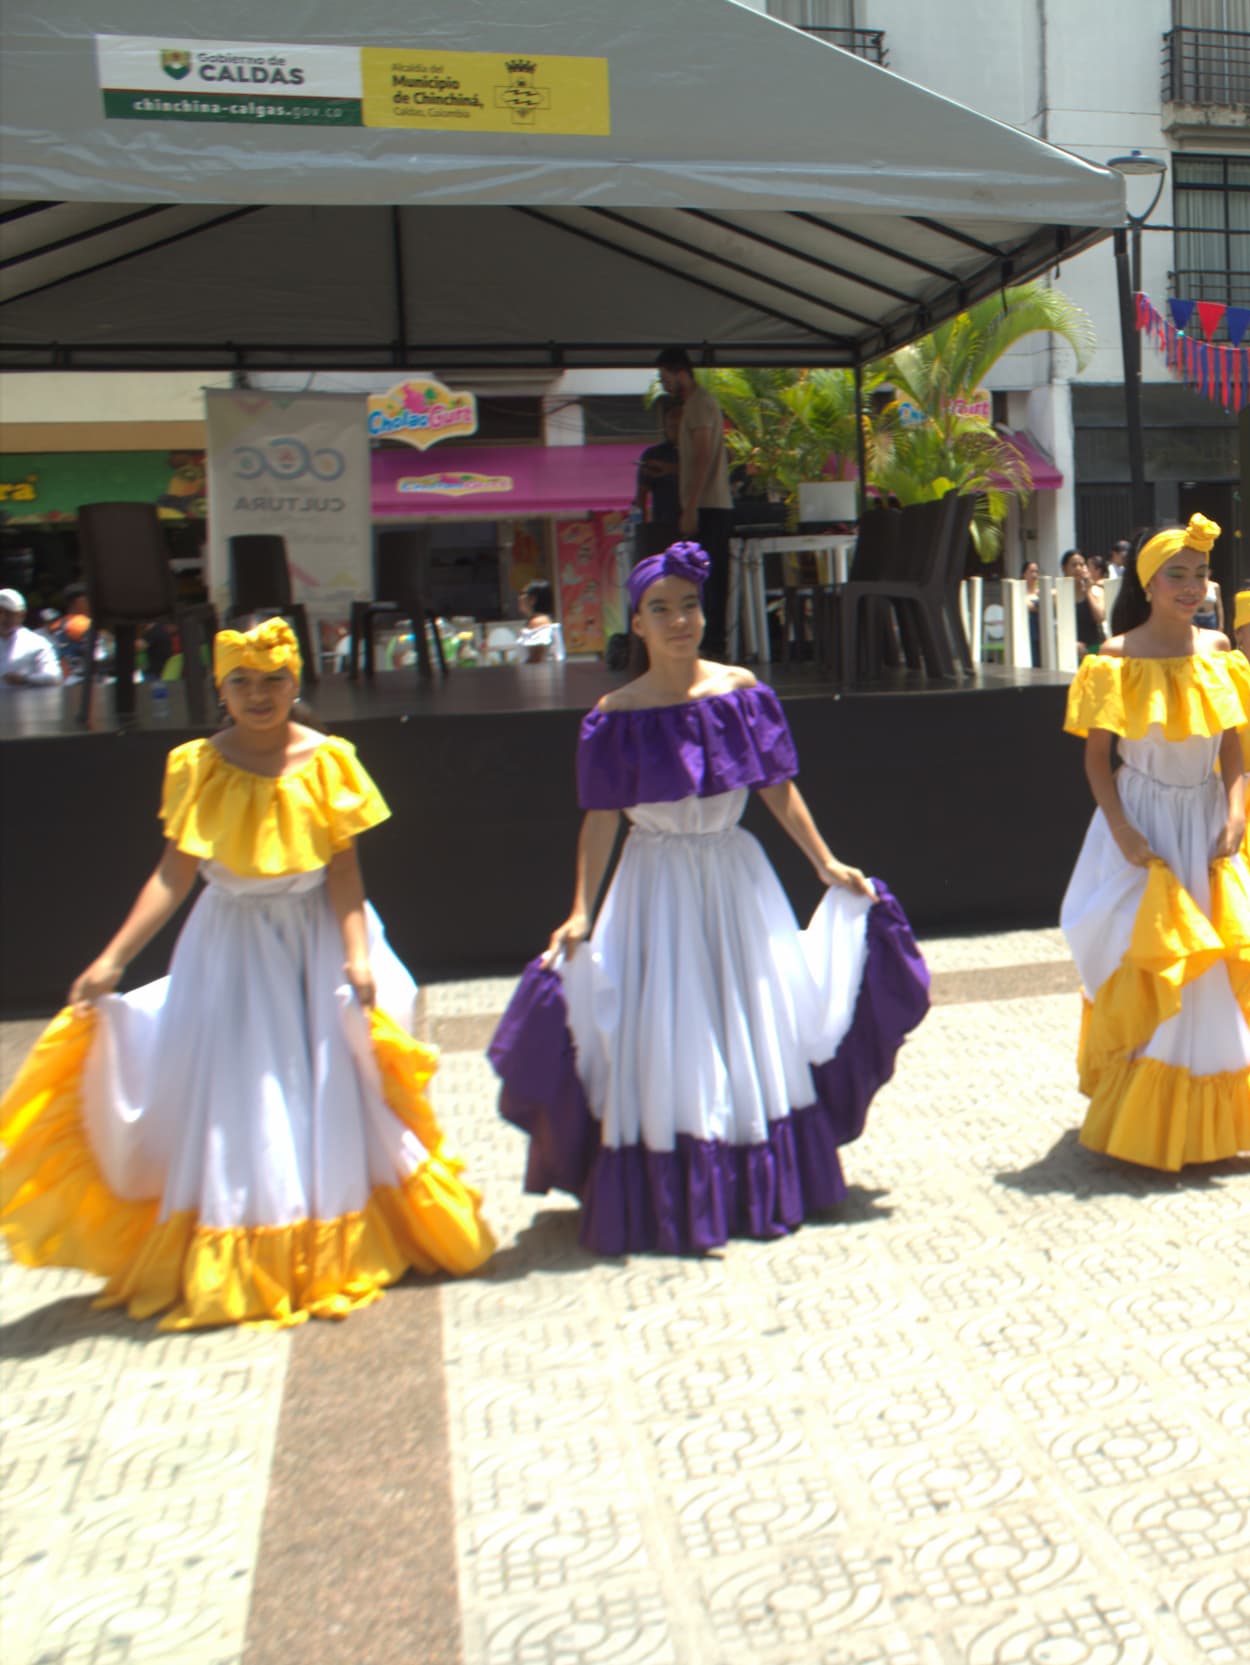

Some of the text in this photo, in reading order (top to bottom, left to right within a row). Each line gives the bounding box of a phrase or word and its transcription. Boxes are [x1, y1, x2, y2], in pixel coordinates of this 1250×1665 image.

[198, 53, 286, 66] Gobierno de
[199, 65, 305, 85] CALDAS
[392, 75, 460, 91] Municipio
[393, 90, 410, 103] de
